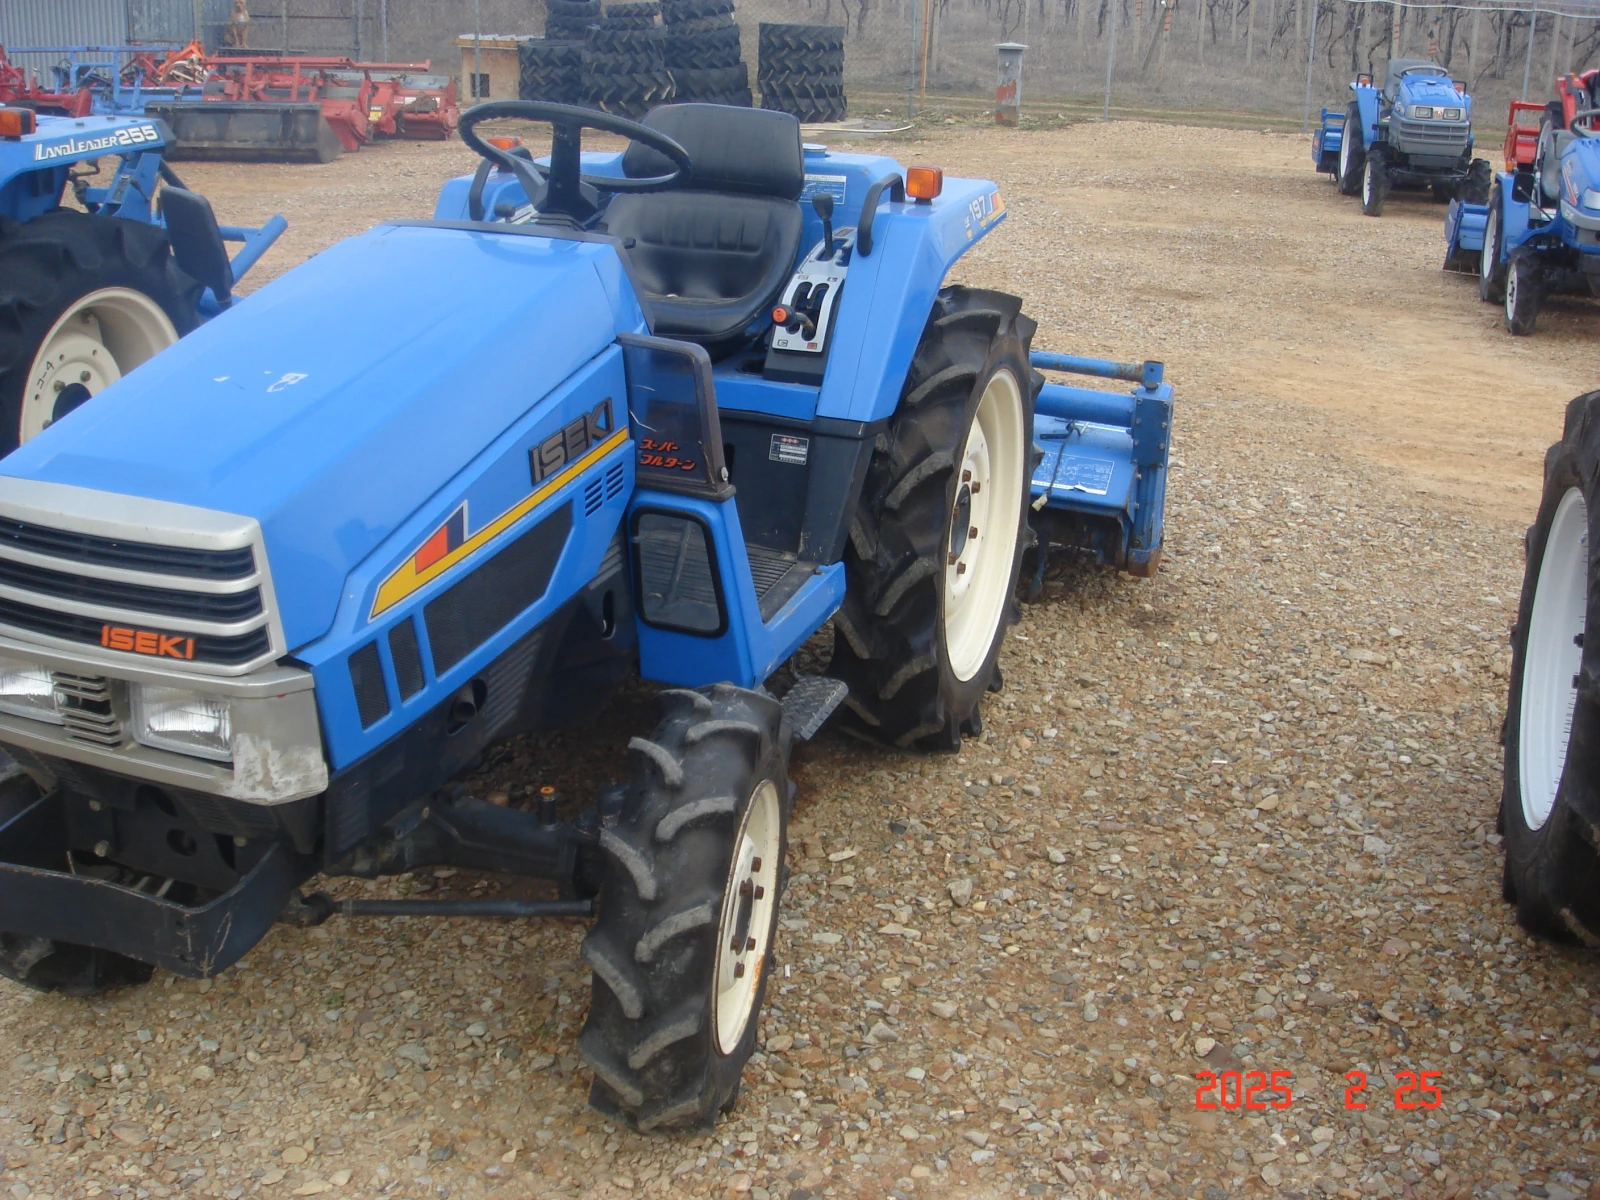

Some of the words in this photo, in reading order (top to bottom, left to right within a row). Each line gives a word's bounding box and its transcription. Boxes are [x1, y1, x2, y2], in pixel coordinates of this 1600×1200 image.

[114, 125, 158, 145] 255
[528, 396, 614, 487] ISEKI
[639, 438, 678, 451] スーパー
[639, 454, 695, 470] フルターン
[101, 624, 195, 660] ISEKI
